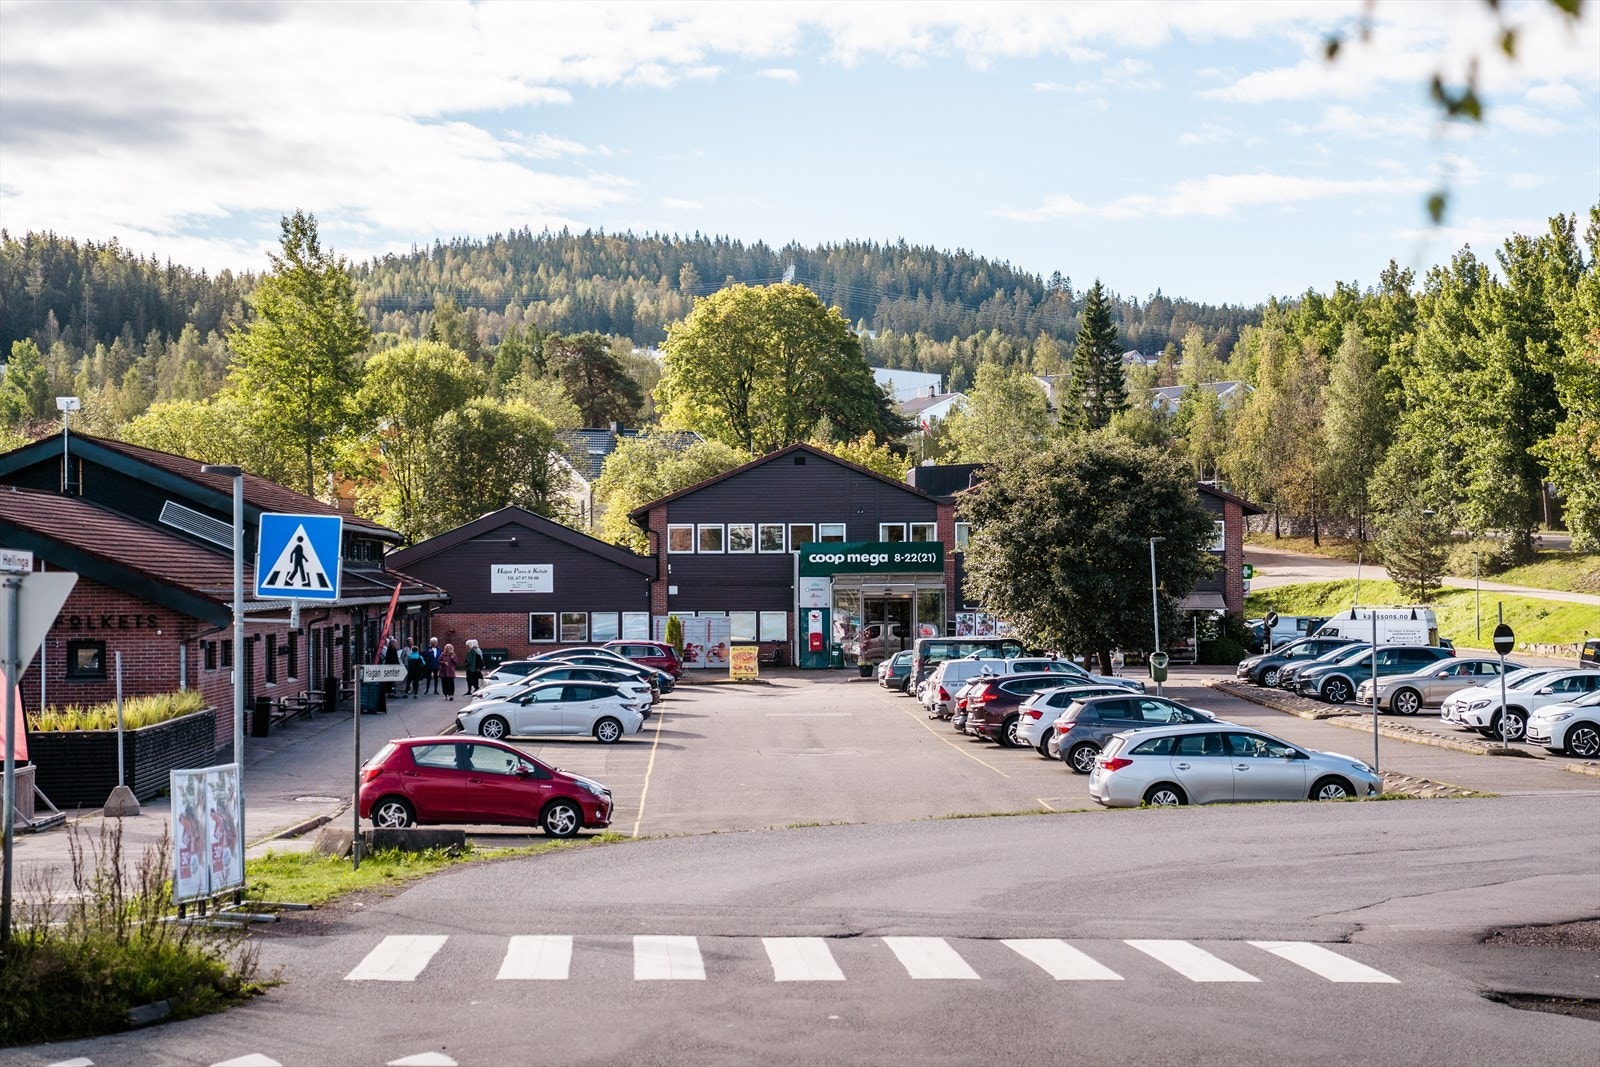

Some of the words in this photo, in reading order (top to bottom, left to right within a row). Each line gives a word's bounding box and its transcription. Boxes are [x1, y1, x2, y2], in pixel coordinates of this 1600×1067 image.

[3, 553, 29, 570] Hellinga
[808, 553, 845, 565] coop
[847, 553, 888, 566] mega
[894, 552, 936, 563] 8-22(21)
[54, 614, 159, 629] FOLKETS
[366, 668, 380, 680] Hagan
[384, 669, 400, 677] senter
